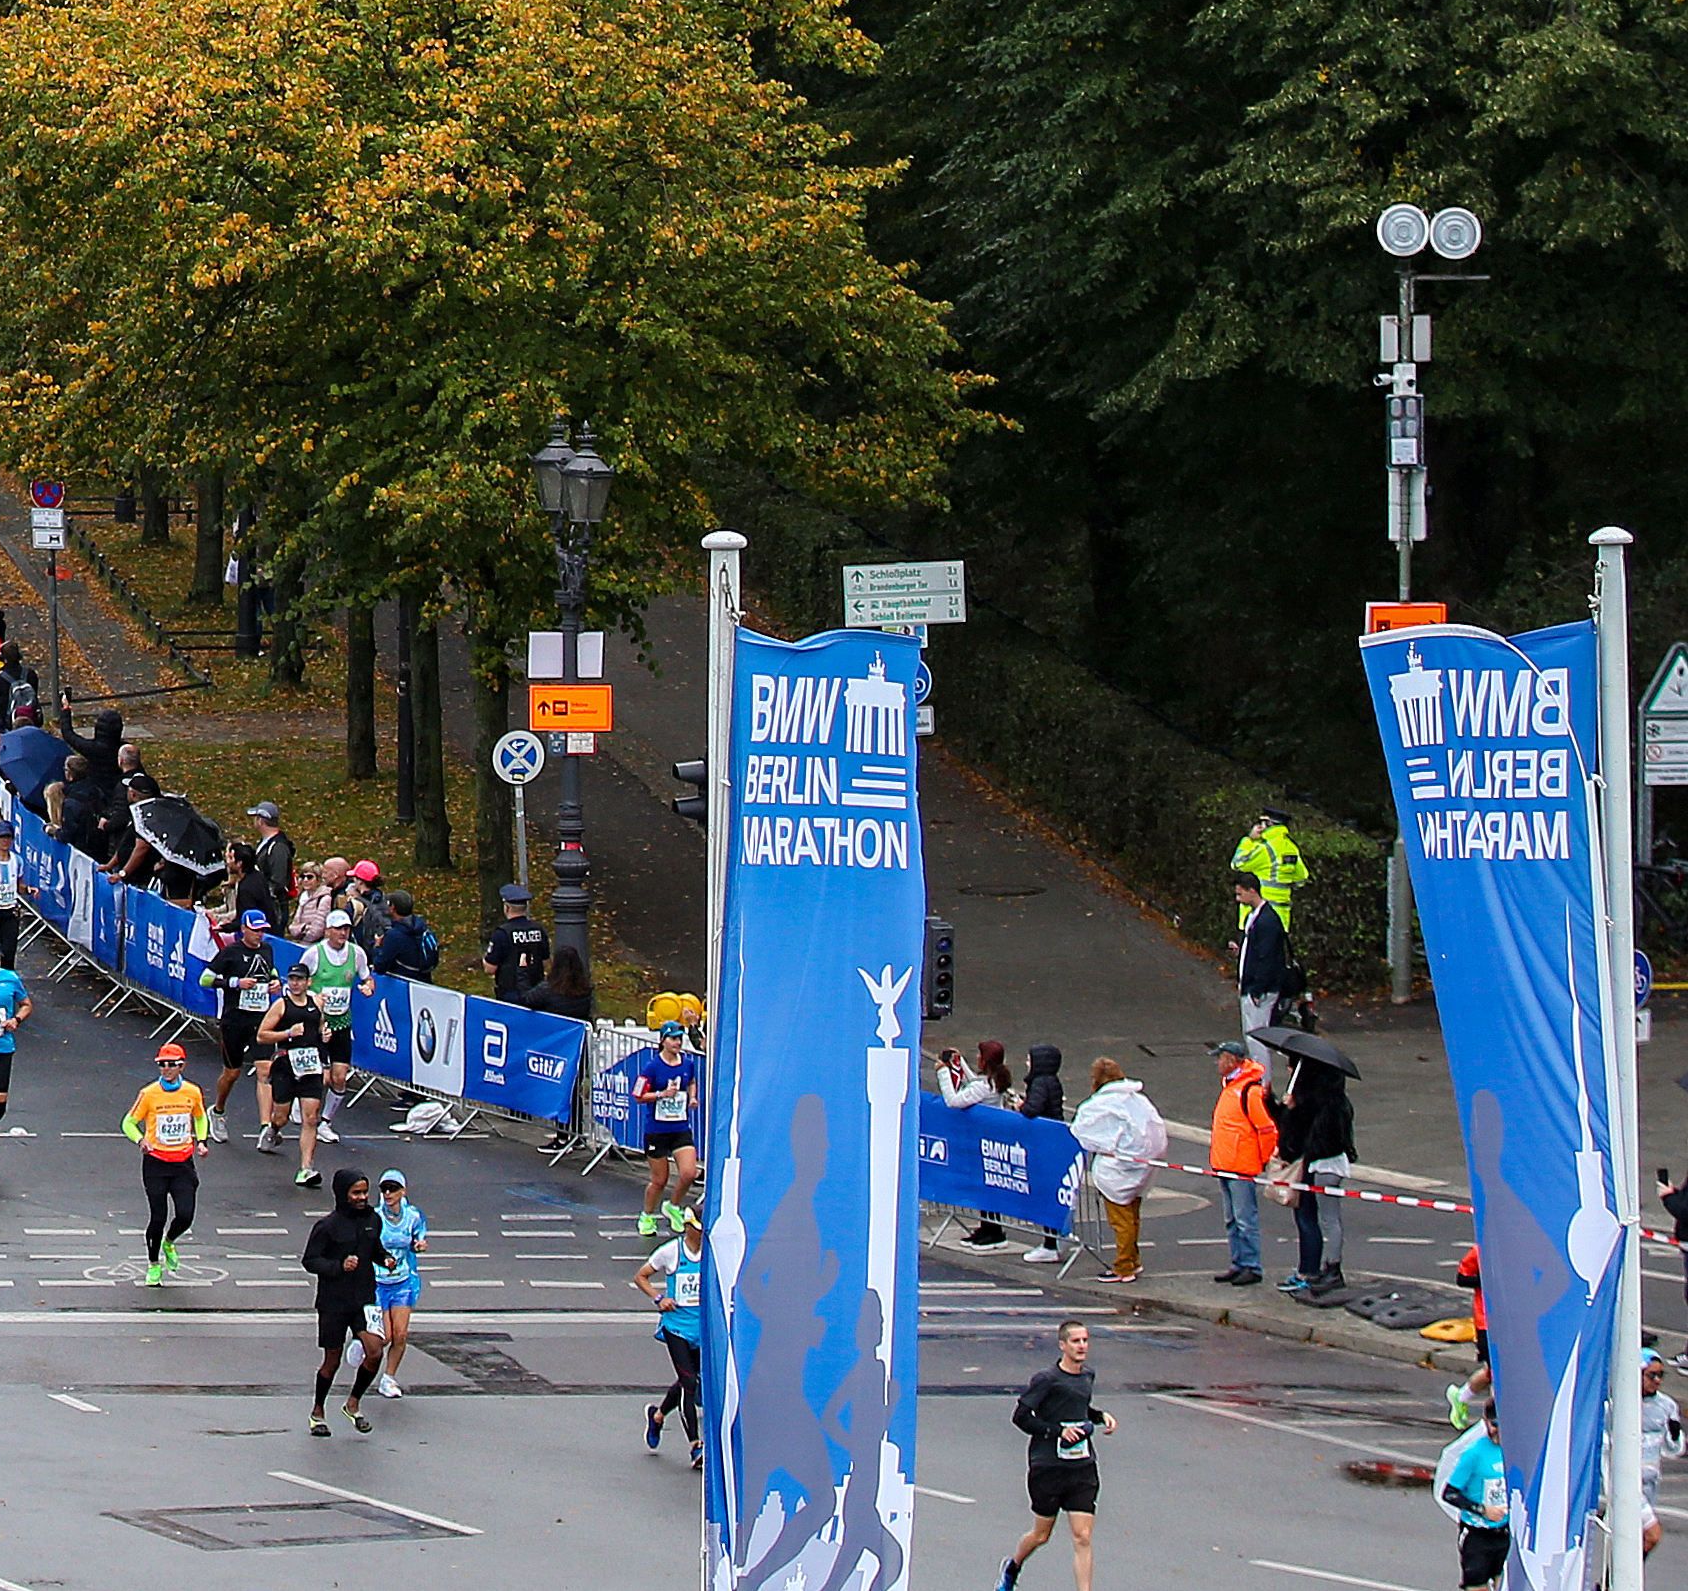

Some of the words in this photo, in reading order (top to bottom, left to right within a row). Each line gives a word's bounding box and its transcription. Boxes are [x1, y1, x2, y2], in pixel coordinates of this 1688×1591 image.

[751, 674, 841, 744] BMW
[745, 755, 838, 805] BERLIN
[742, 816, 908, 869] MARATHON
[981, 1138, 1009, 1161] BMW
[983, 1158, 1011, 1176] BERLIN
[985, 1172, 1030, 1195] MARATHON
